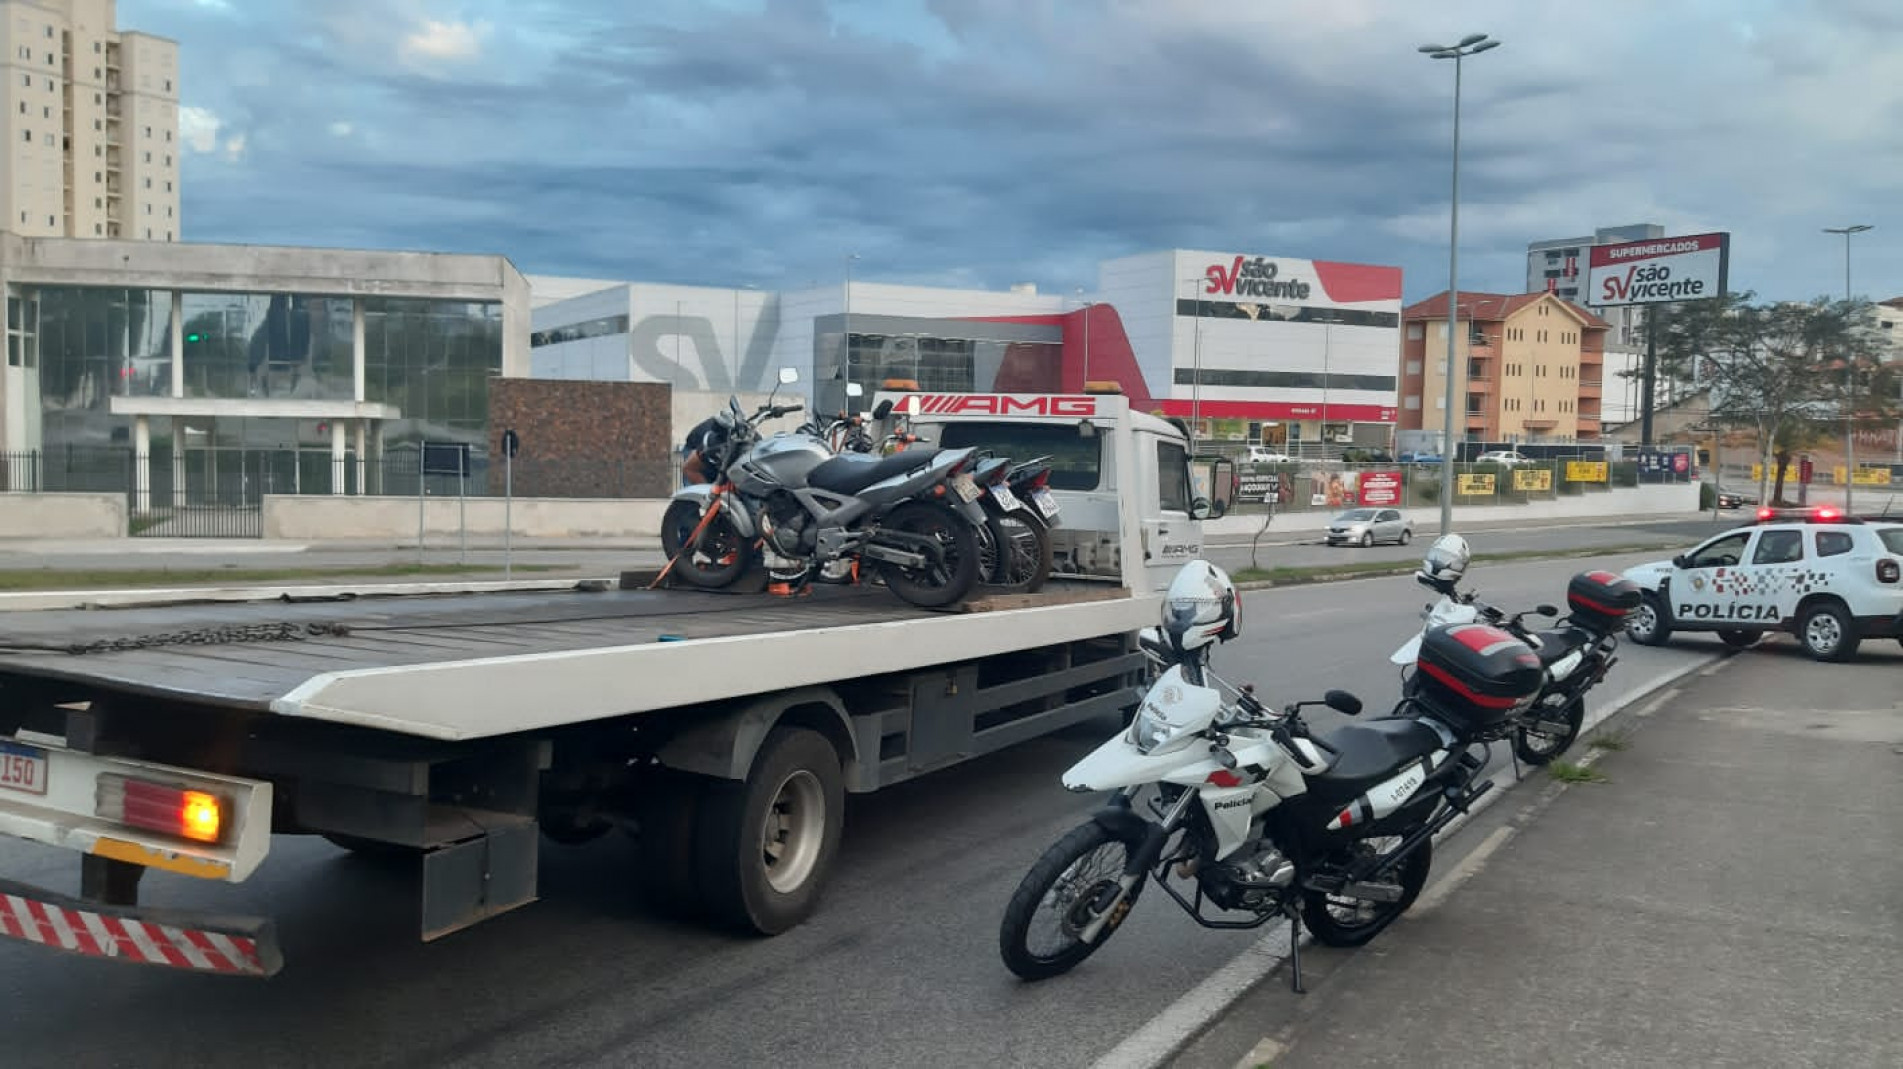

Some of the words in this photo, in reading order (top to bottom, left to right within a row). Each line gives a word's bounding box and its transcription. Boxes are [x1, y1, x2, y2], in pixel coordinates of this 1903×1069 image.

[1609, 240, 1699, 259] SUPERMERCADOS
[1206, 256, 1244, 295] SV
[1240, 257, 1278, 280] são
[1634, 264, 1670, 283] são
[1236, 278, 1310, 300] vicente
[1602, 265, 1638, 301] SV
[1631, 277, 1704, 299] vicente
[1679, 601, 1779, 620] POLÍCIA
